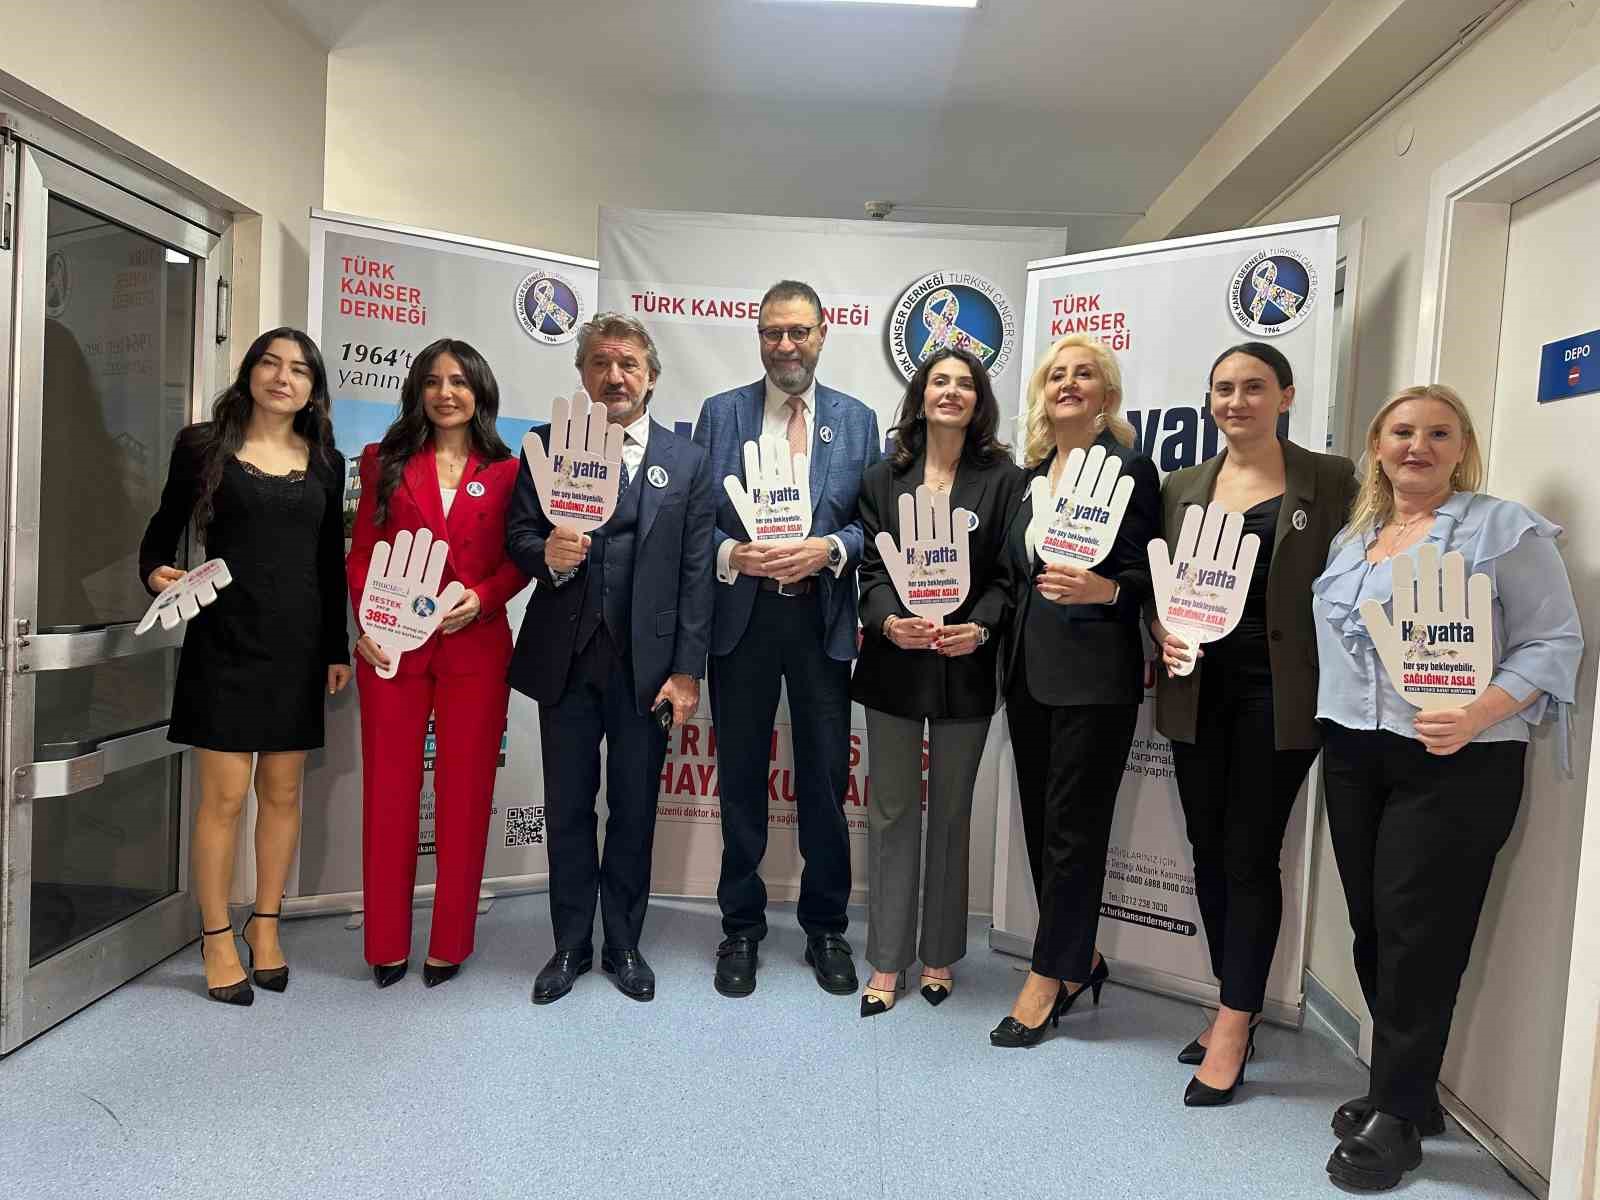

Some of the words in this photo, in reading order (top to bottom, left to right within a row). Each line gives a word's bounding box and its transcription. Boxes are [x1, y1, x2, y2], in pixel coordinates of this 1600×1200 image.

[341, 256, 395, 280] TÜRK
[341, 277, 421, 304] KANSER
[904, 272, 945, 311] DERNEĞİ
[949, 273, 993, 296] TURKISH
[340, 298, 427, 326] DERNEĞİ
[631, 291, 685, 315] TÜRK
[691, 299, 760, 320] KANSE
[820, 304, 869, 326] NEĞİ
[992, 293, 1015, 336] CANCER
[1053, 294, 1101, 316] TÜRK
[893, 311, 907, 357] KANSER
[1051, 312, 1125, 337] KANSER
[341, 343, 413, 369] 1964't
[991, 339, 1014, 378] SOCIET
[1564, 344, 1591, 362] DEPO
[338, 368, 401, 390] yanın
[365, 608, 397, 627] 3853
[1403, 662, 1414, 670] her
[1403, 672, 1449, 686] SAĞLIĞINIZ
[1450, 675, 1475, 686] ASLA!
[660, 761, 720, 797] HAY
[684, 808, 709, 818] doktor
[1135, 863, 1158, 876] Akbank
[1126, 874, 1143, 885] 6000
[1162, 881, 1179, 893] 8000
[1151, 901, 1168, 913] 3030
